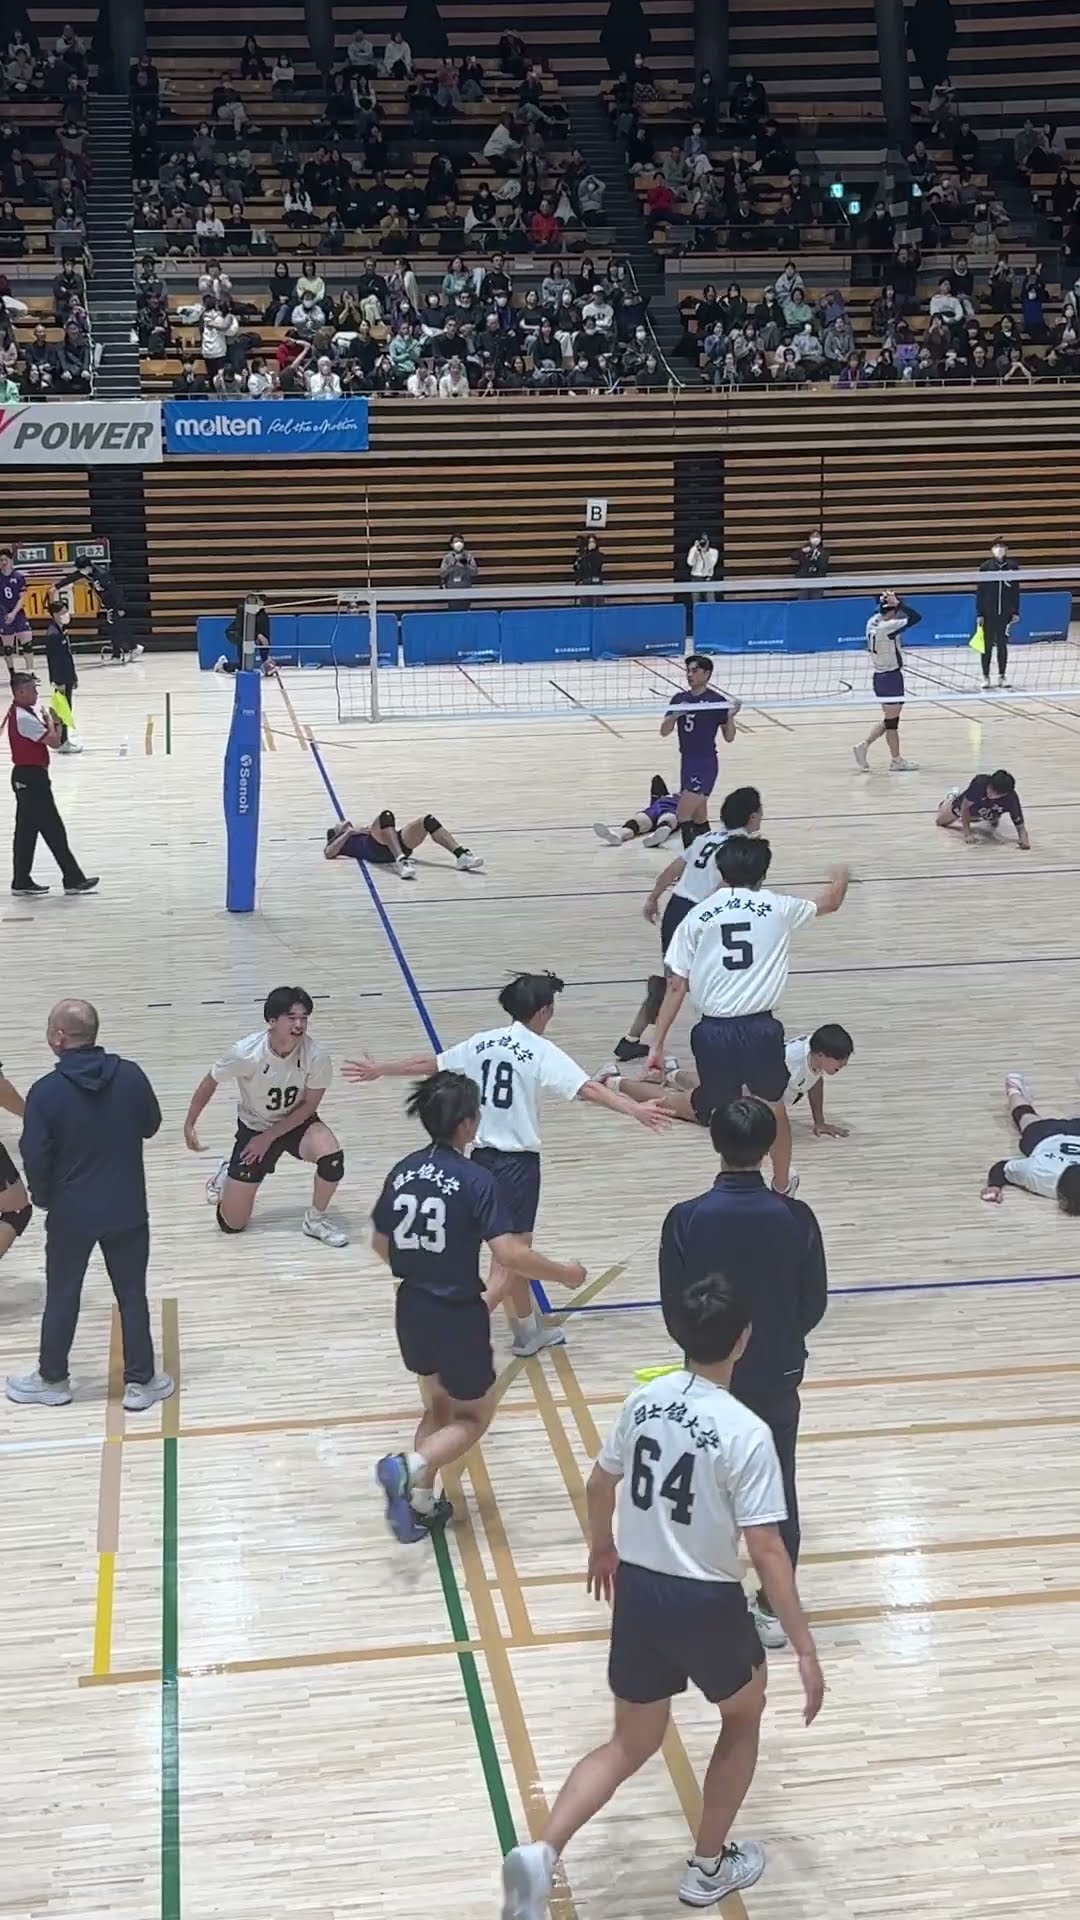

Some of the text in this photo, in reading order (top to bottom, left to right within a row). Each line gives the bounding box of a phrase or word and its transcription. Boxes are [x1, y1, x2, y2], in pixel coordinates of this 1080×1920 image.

[14, 422, 154, 450] POWER
[175, 415, 261, 436] molten
[591, 506, 602, 521] B
[684, 713, 695, 732] 5
[239, 767, 250, 814] Senoh
[720, 921, 755, 971] 5
[266, 1086, 299, 1111] 38
[481, 1059, 513, 1110] 18
[393, 1193, 447, 1254] 23
[631, 1434, 696, 1526] 64
